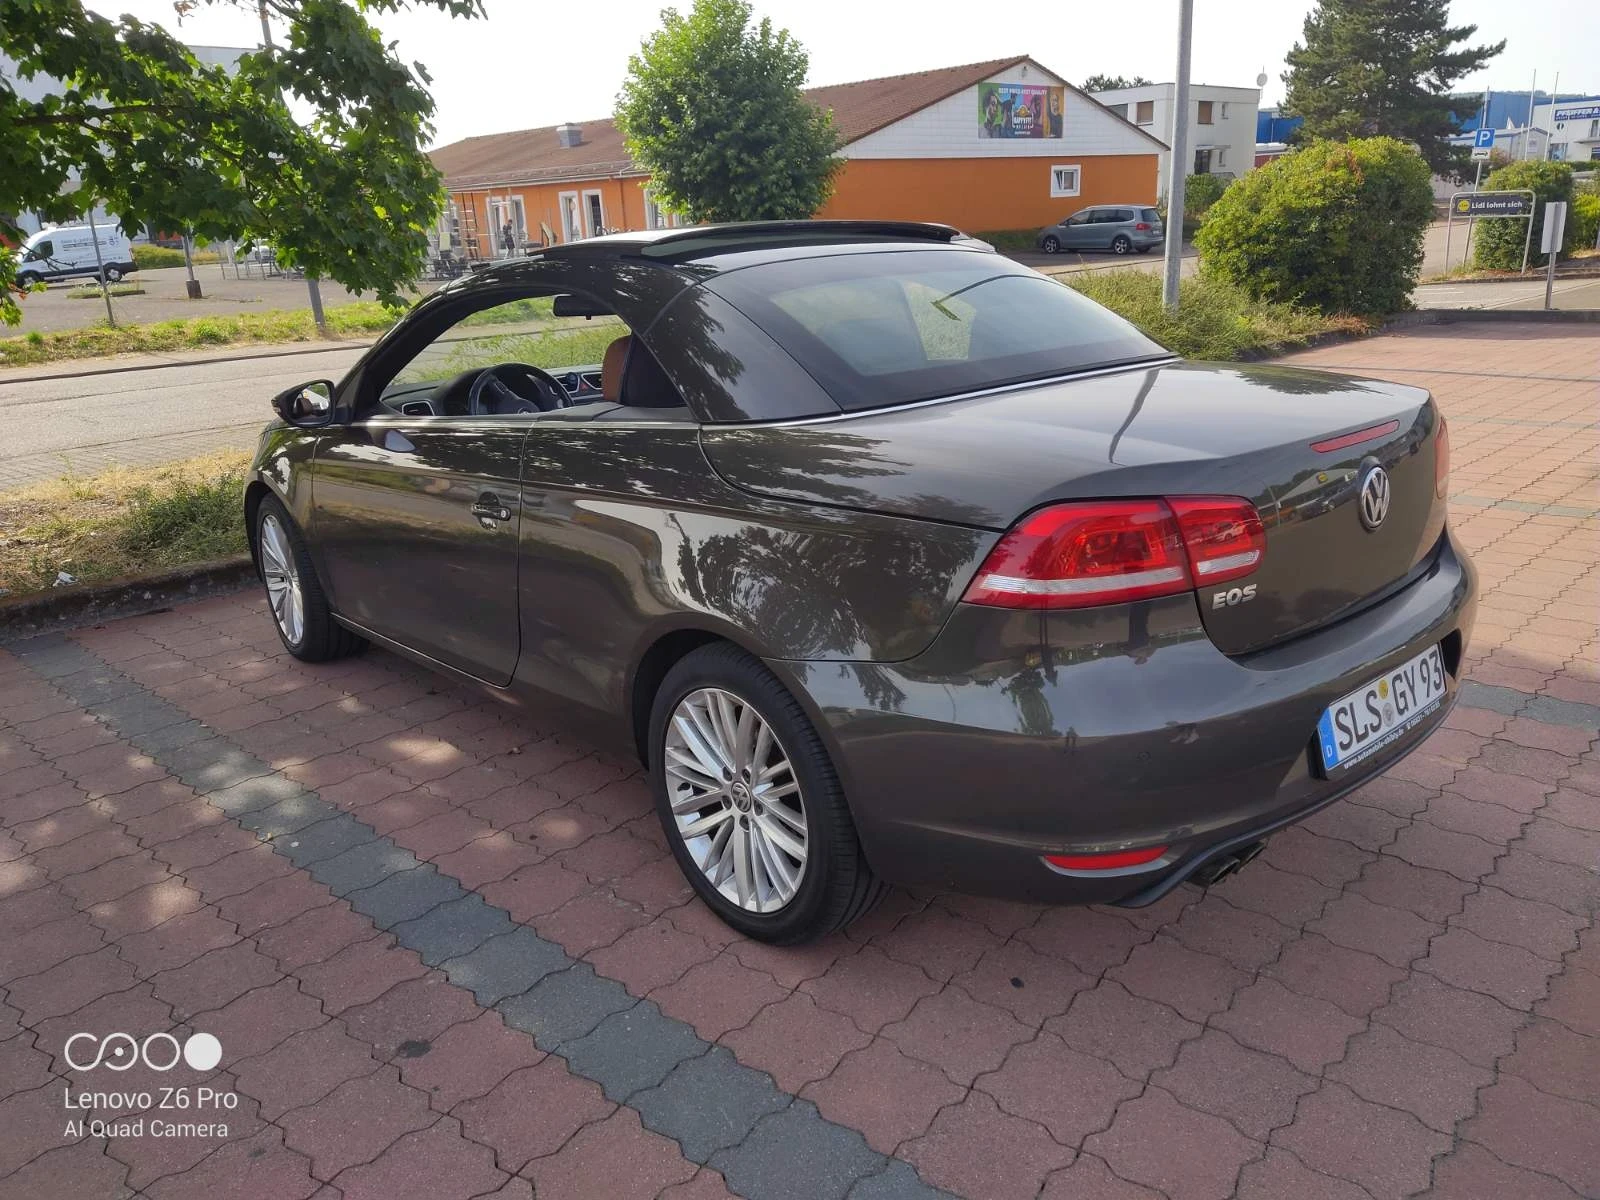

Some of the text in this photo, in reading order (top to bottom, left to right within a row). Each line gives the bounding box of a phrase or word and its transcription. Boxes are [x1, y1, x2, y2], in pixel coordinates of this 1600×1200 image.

[1479, 130, 1490, 146] P
[1212, 584, 1257, 610] EOS
[1335, 650, 1442, 751] SLS GY 93
[1325, 744, 1333, 758] D
